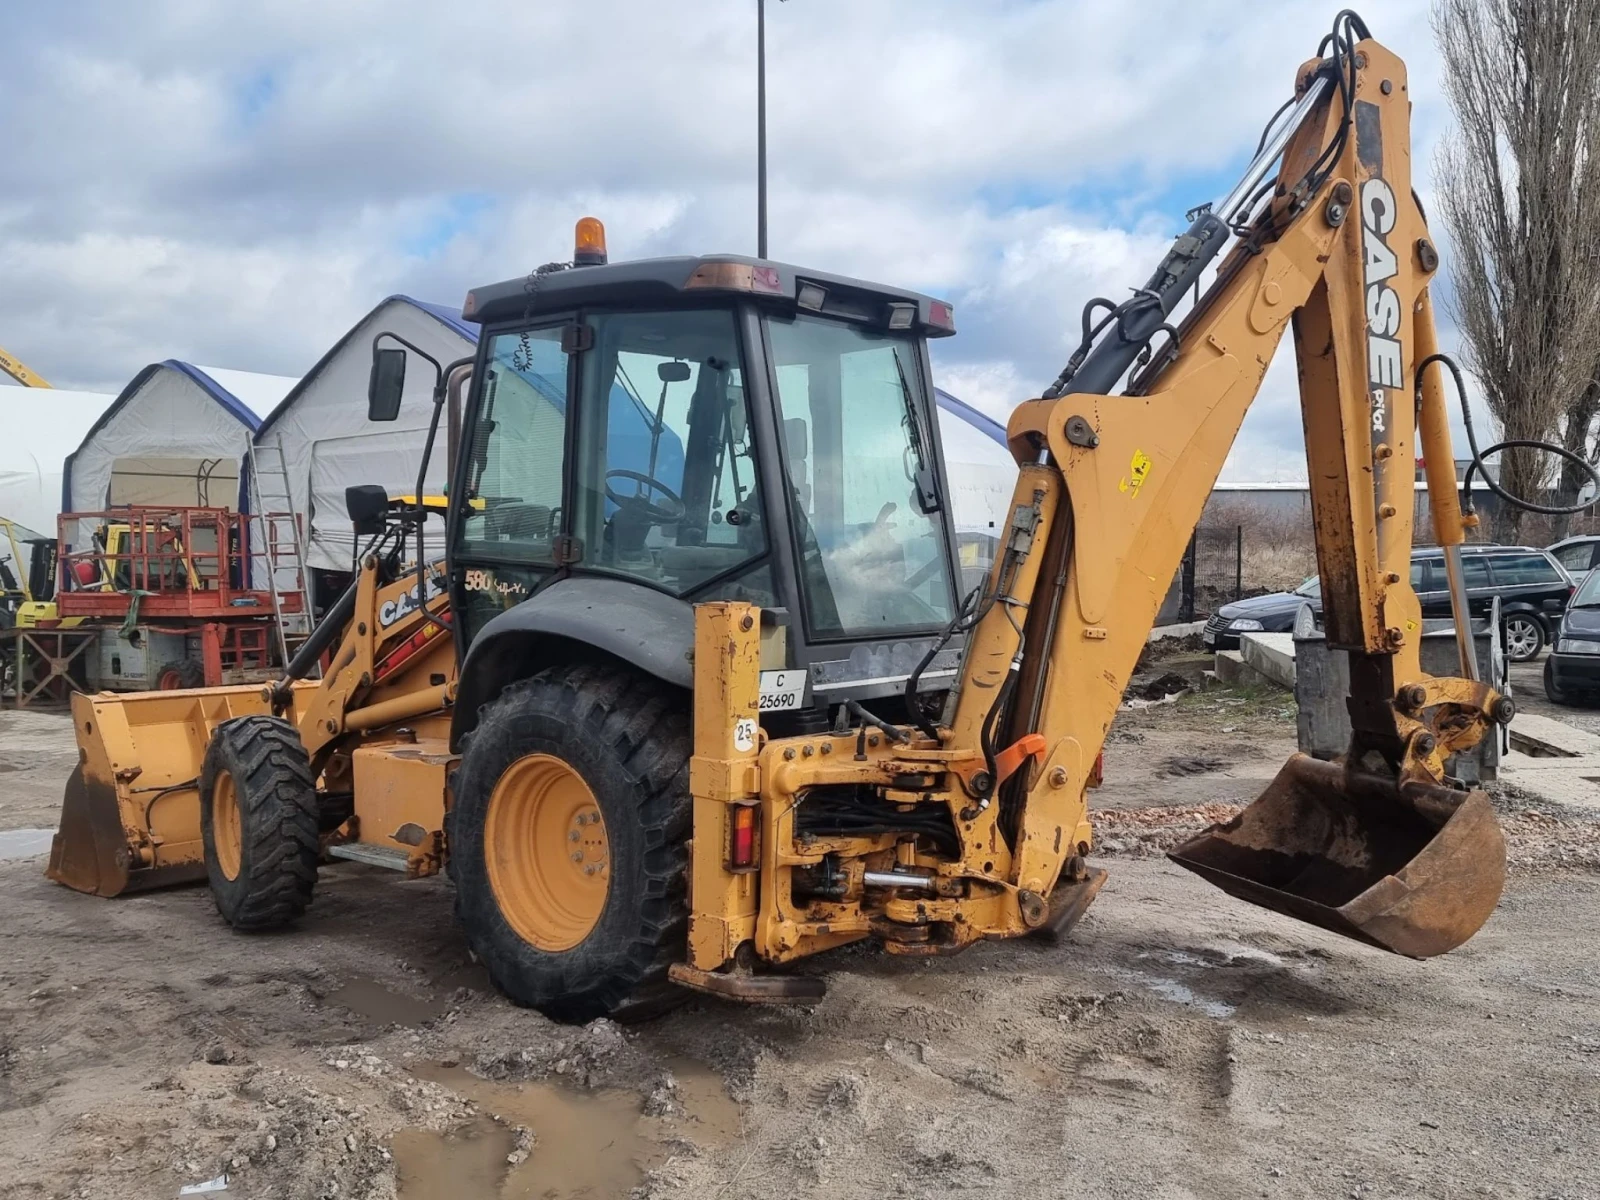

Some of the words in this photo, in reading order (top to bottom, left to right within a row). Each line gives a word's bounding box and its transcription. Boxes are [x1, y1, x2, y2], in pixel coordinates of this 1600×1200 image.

[1361, 178, 1403, 389] CASE
[1372, 389, 1385, 432] Pilot
[464, 570, 491, 591] 580
[776, 674, 785, 687] C
[758, 693, 795, 709] 25690
[737, 724, 752, 741] 25
